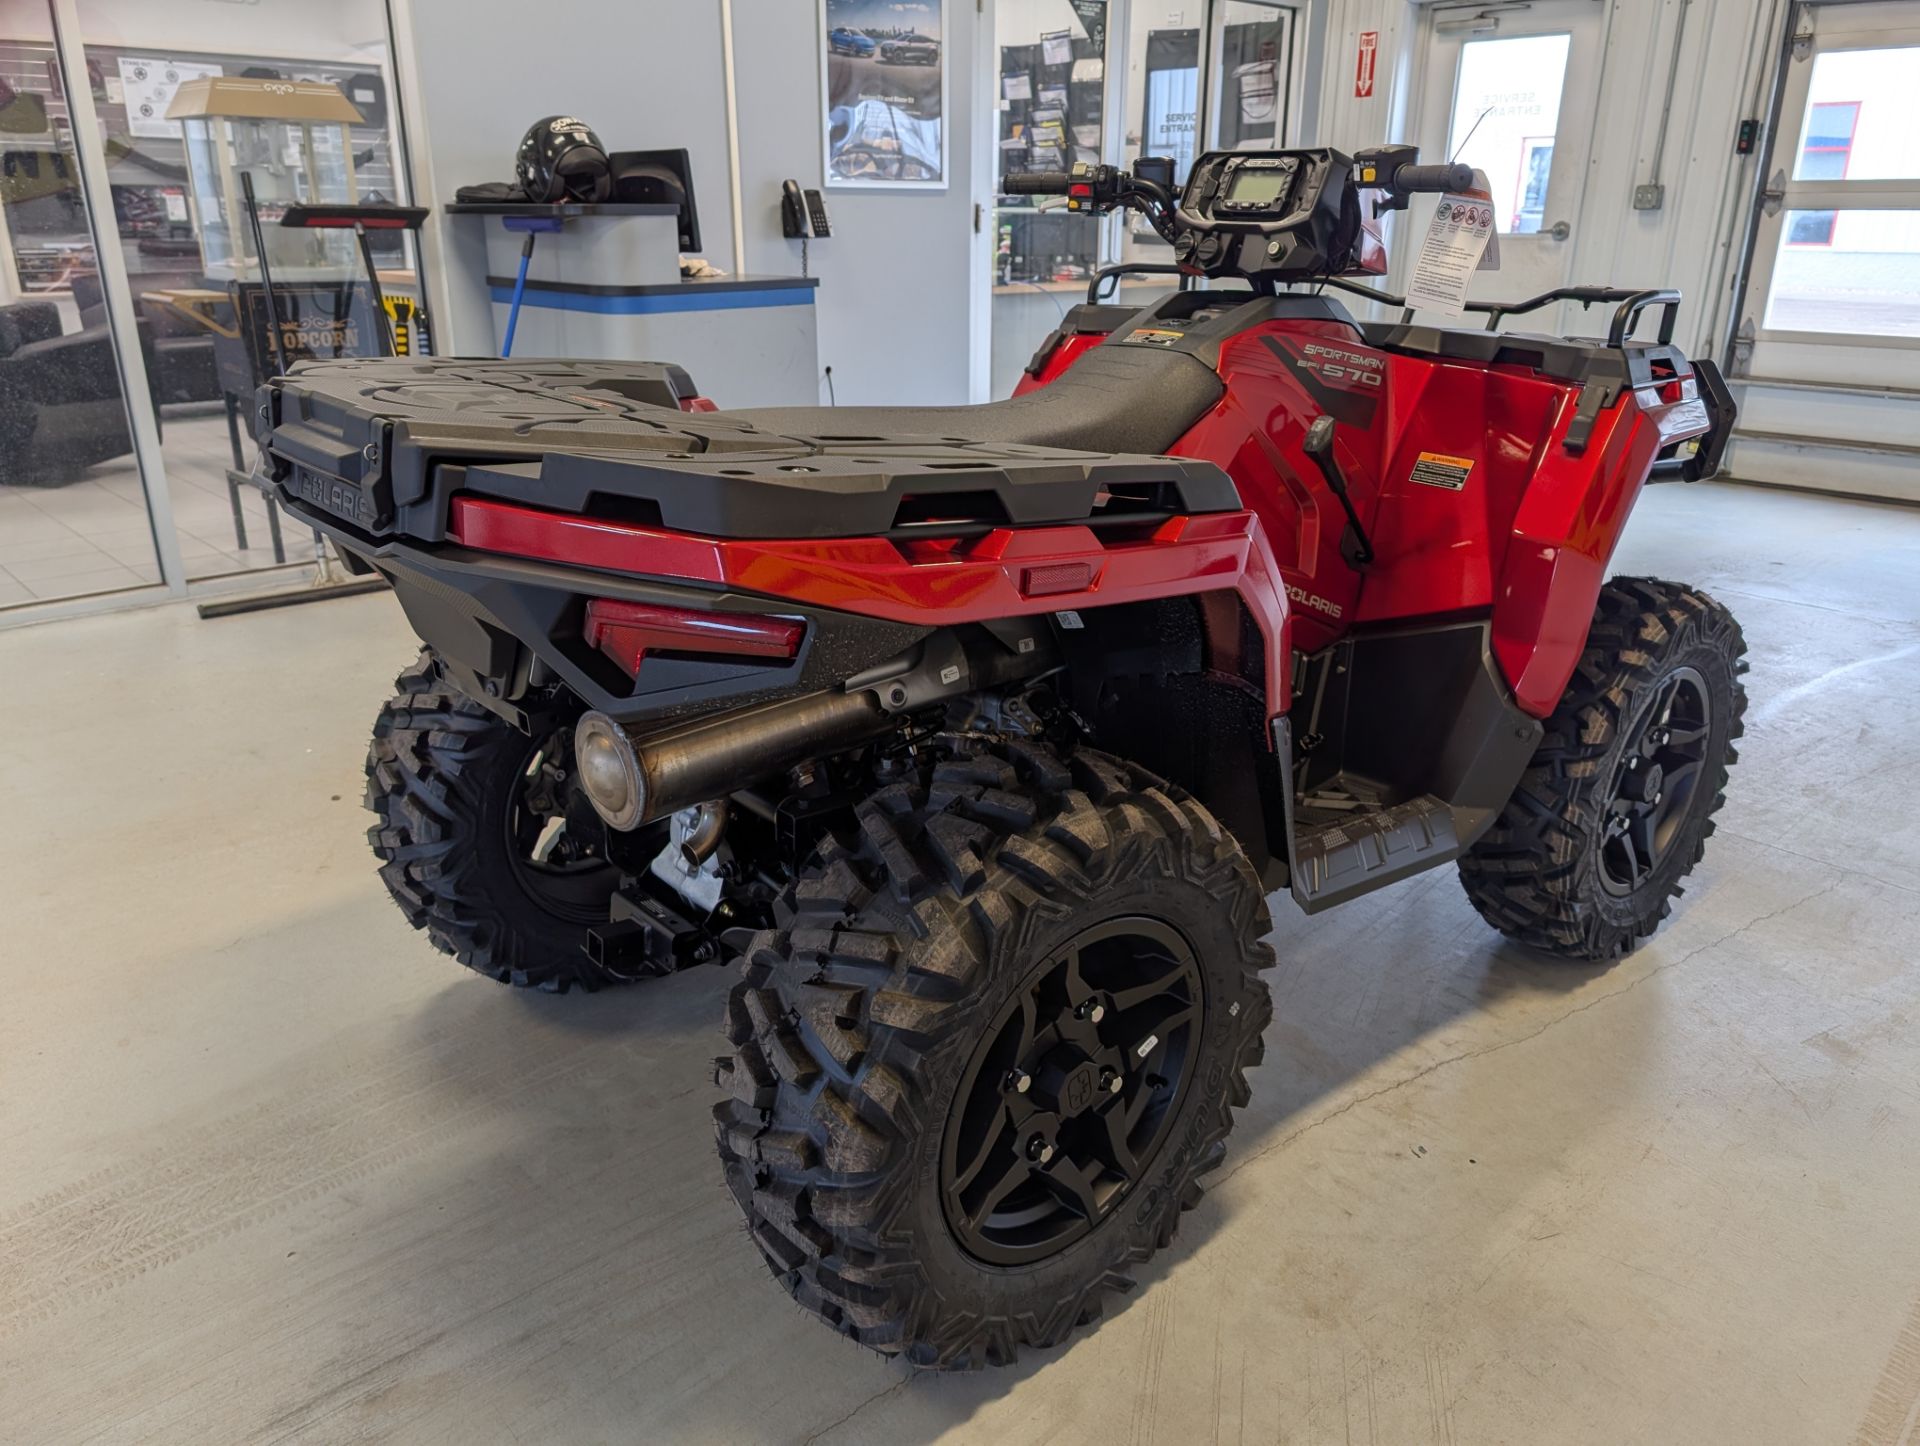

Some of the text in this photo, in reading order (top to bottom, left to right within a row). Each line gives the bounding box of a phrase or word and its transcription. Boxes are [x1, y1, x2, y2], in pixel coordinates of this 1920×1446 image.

[1160, 123, 1196, 134] ENTRAN
[1165, 112, 1197, 123] SERVIC
[1304, 343, 1385, 370] SPORTSMAN
[1297, 359, 1382, 387] EFI 570
[1284, 582, 1343, 619] POLARIS
[1136, 1058, 1227, 1226] DURO
